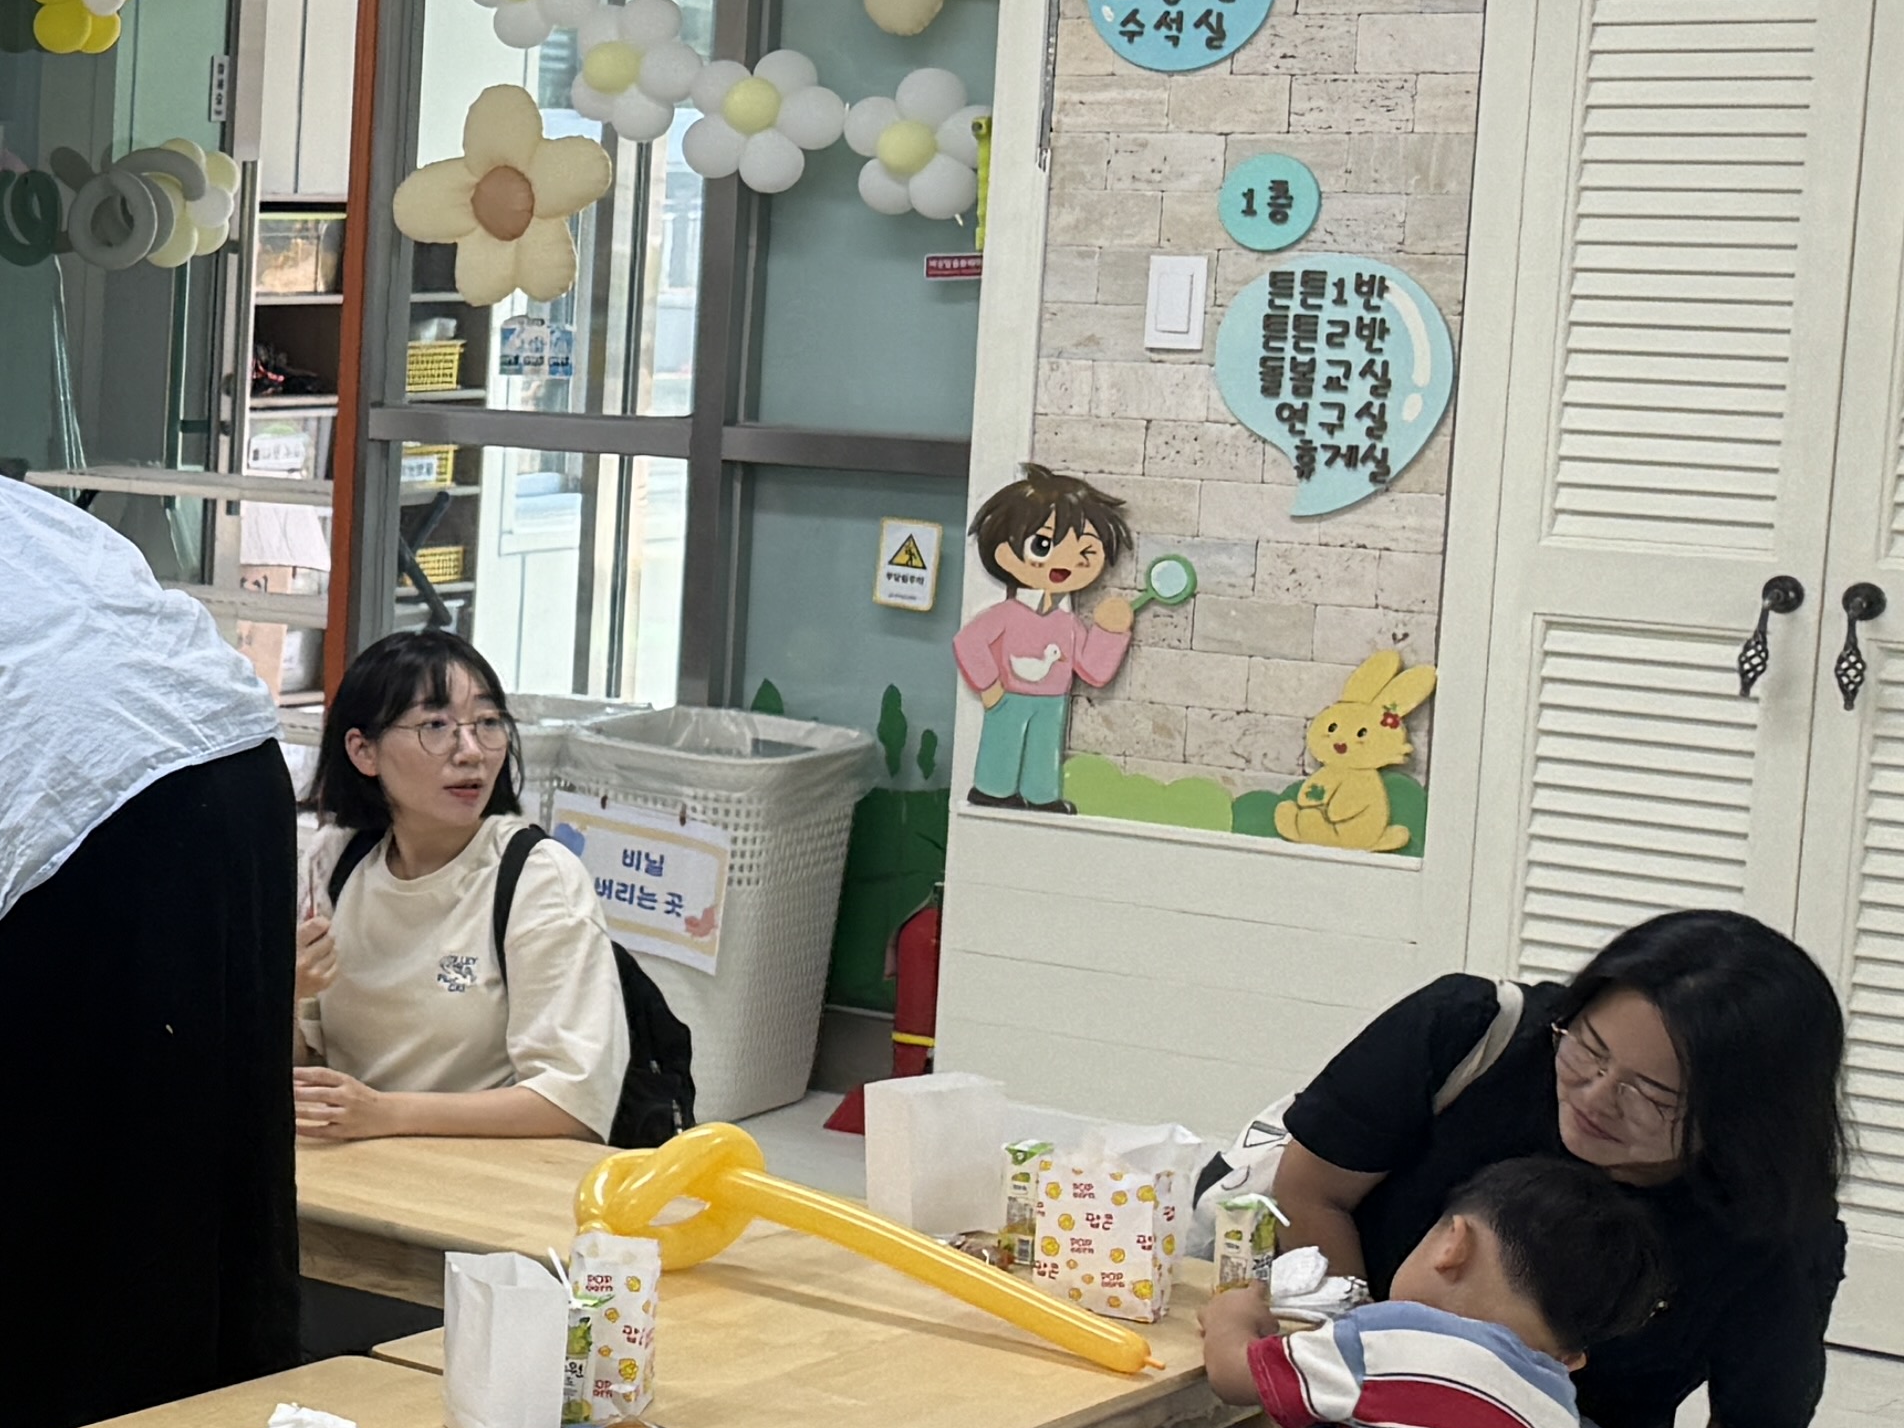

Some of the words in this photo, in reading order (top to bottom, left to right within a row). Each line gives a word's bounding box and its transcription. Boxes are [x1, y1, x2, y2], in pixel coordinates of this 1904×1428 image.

[1119, 8, 1226, 49] 수석실
[1241, 179, 1294, 225] 1층
[1268, 270, 1389, 312] 튼튼1반
[1262, 314, 1390, 354] 튼튼2반
[1259, 356, 1391, 399] 돌봄교실
[1275, 401, 1388, 440] 연구실
[622, 848, 664, 877] 비닐
[594, 877, 658, 910] 버리는
[664, 892, 684, 917] 곳
